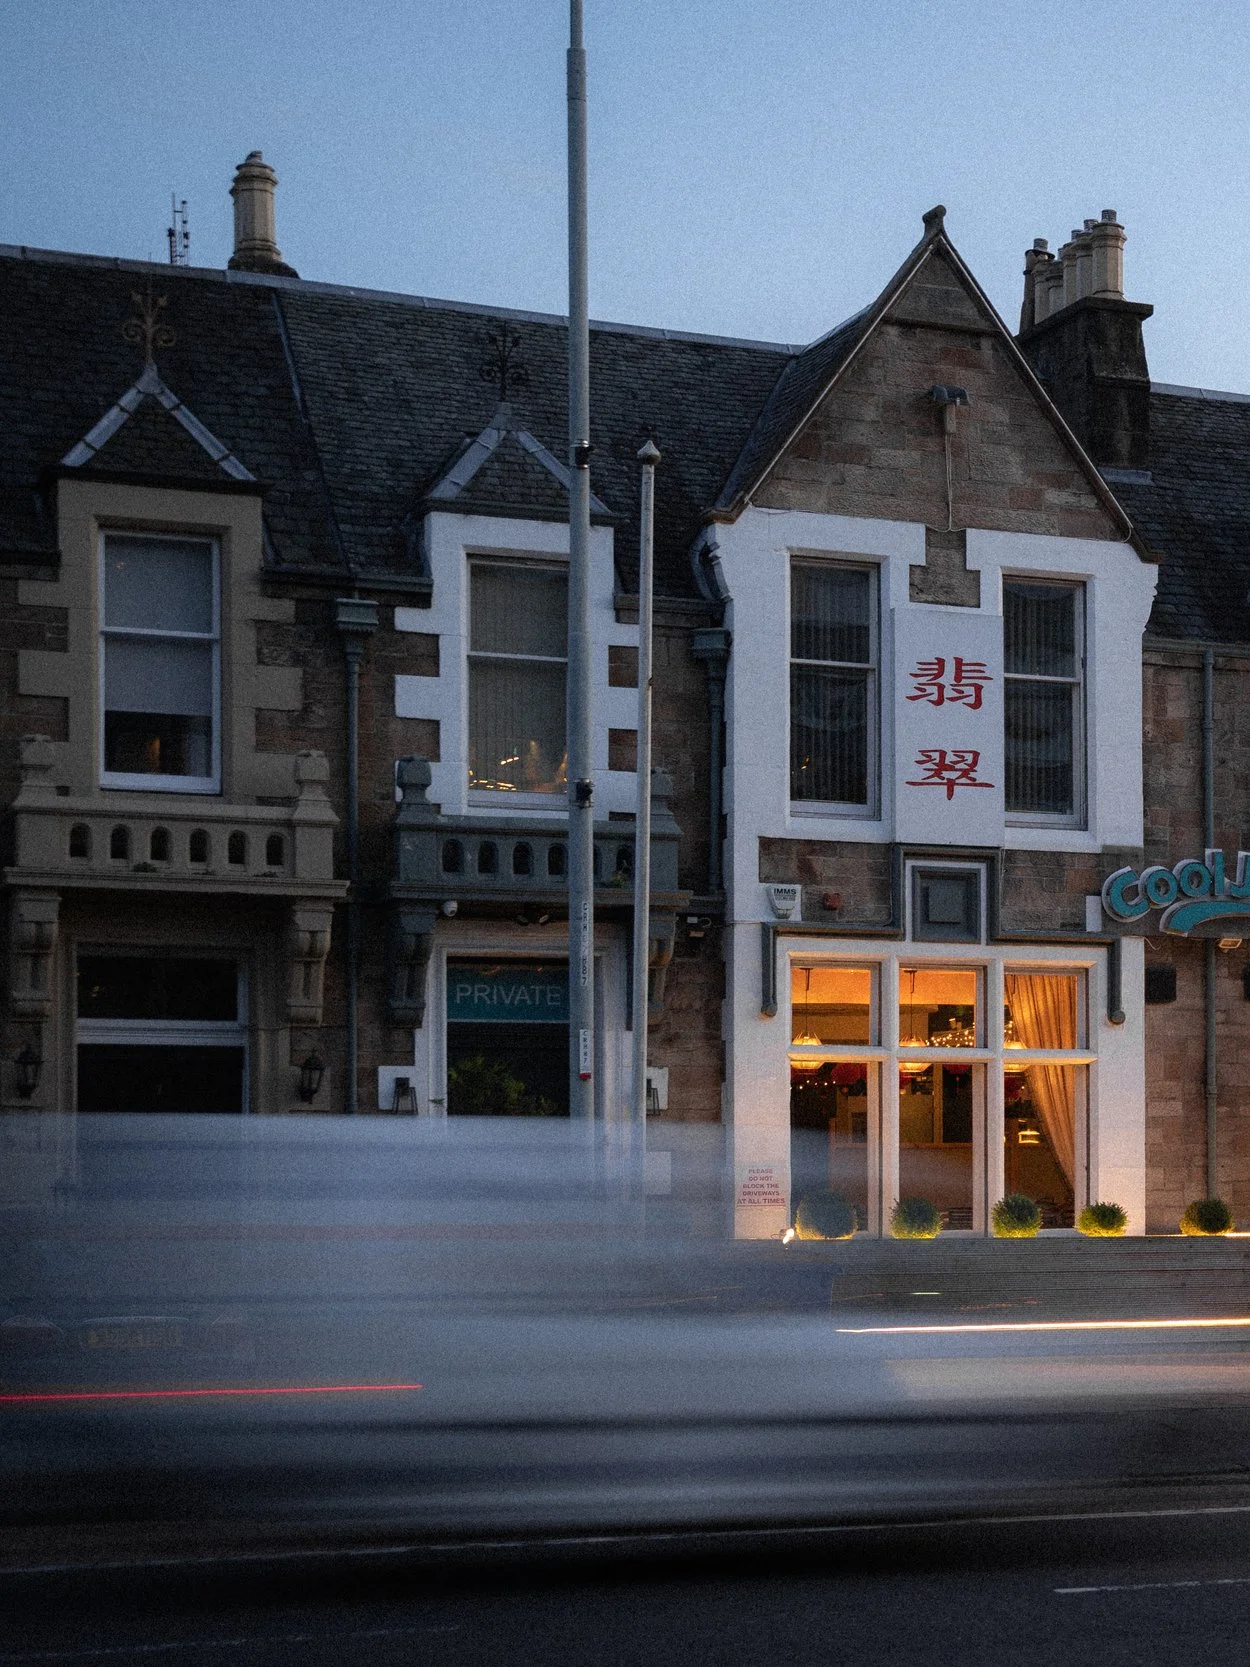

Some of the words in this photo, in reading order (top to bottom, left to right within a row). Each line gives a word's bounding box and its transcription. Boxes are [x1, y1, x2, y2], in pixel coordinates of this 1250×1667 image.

[905, 656, 995, 801] 翡翠
[1102, 848, 1226, 923] Cool
[456, 984, 561, 1005] PRIVATE
